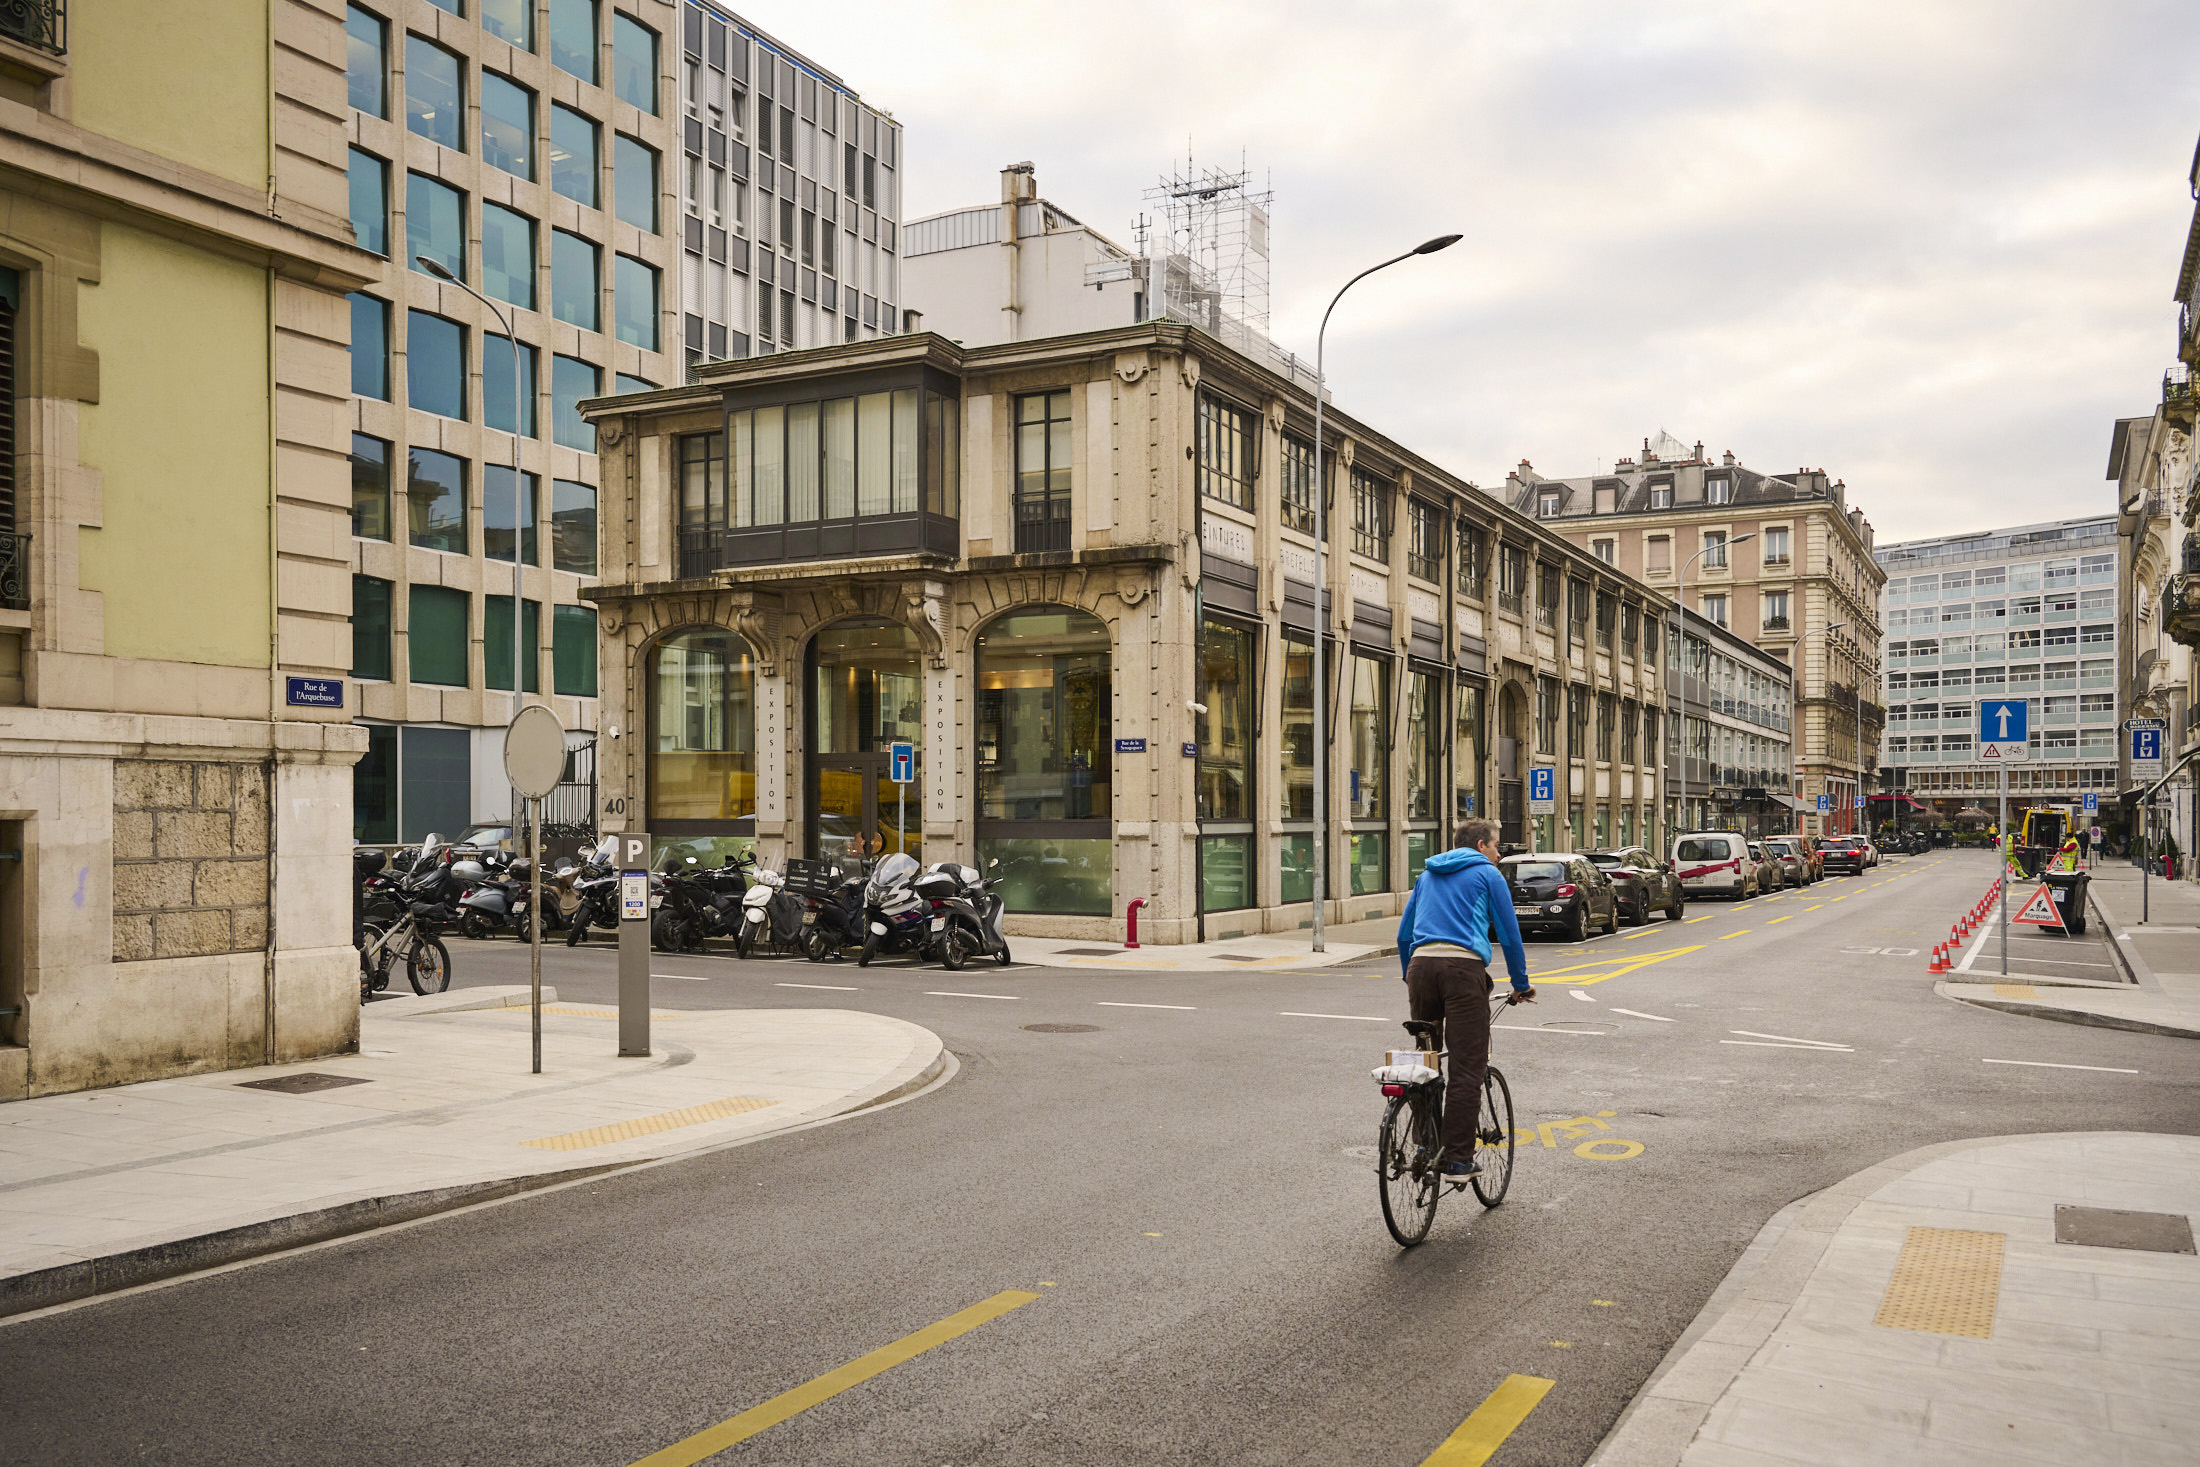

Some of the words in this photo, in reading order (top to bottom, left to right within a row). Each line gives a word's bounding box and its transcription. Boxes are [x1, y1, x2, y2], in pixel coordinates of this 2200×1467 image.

[1203, 521, 1245, 551] EINTURES
[1280, 547, 1316, 576] BRETELLE
[304, 682, 318, 691] Rue
[318, 683, 328, 692] de
[296, 691, 336, 702] l'Arquebuse
[2141, 732, 2152, 747] P
[1537, 770, 1548, 787] P
[604, 797, 626, 815] 40
[627, 839, 644, 863] P
[2024, 912, 2053, 920] Marquage
[1839, 945, 1921, 957] 30
